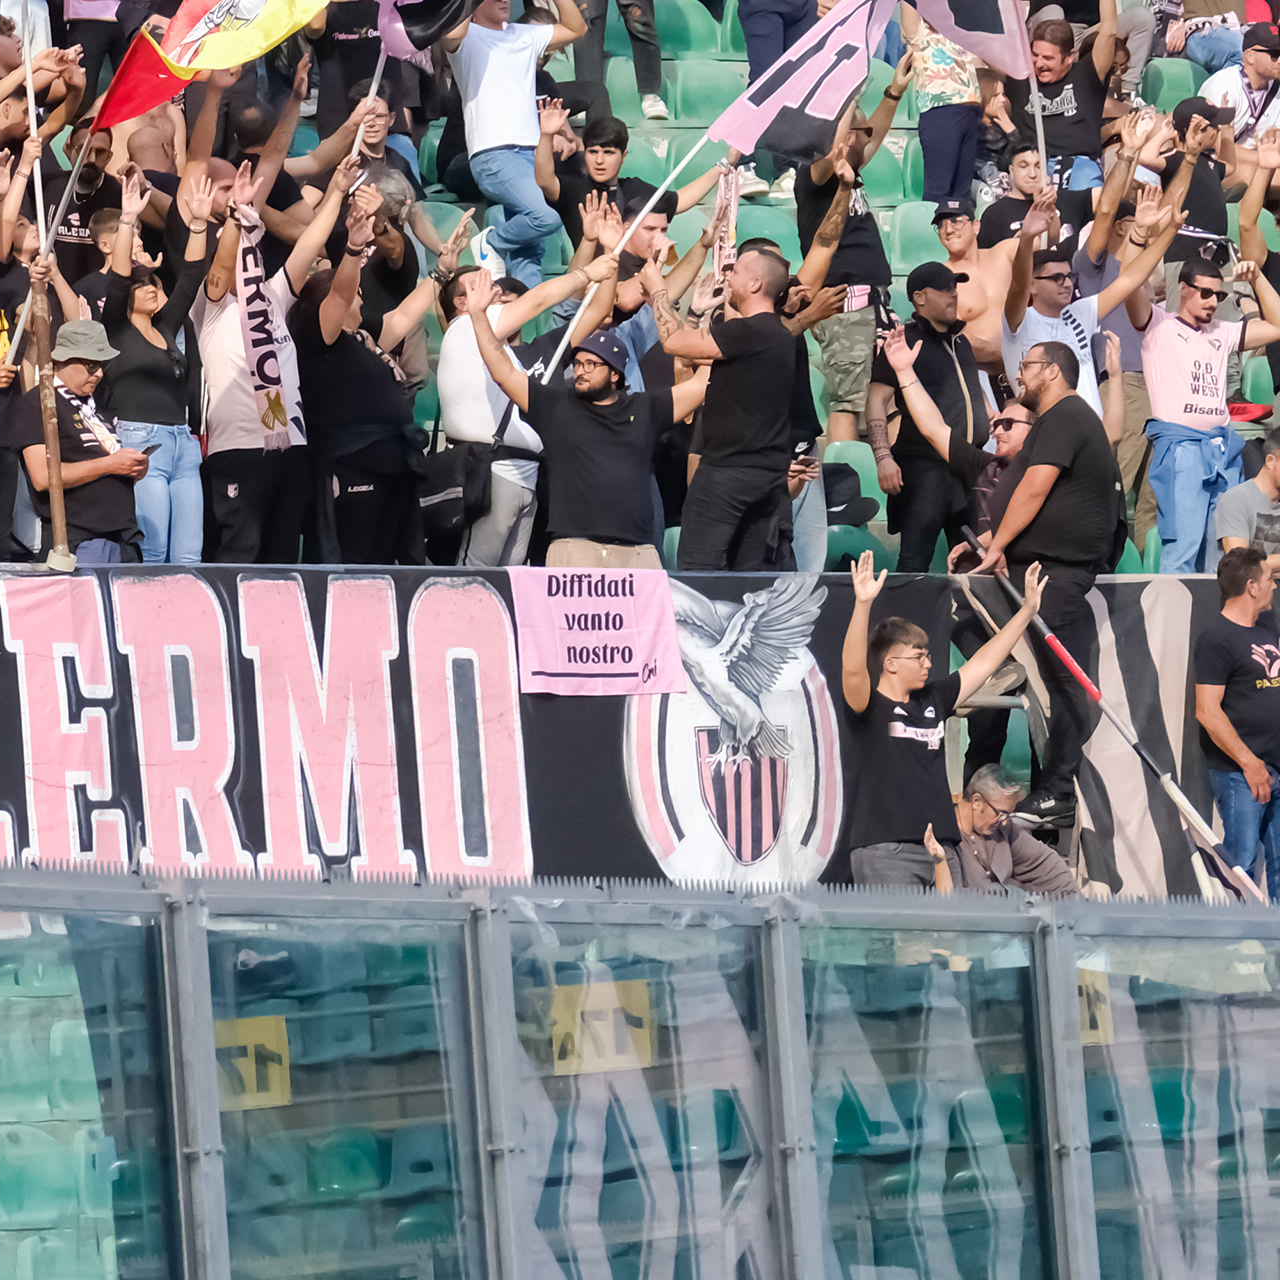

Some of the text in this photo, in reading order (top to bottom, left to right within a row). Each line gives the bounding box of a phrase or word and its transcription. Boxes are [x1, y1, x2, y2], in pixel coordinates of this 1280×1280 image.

[1190, 384, 1221, 399] WEST
[546, 572, 637, 598] Diffidati
[564, 609, 625, 632] vanto
[567, 642, 635, 666] nostro
